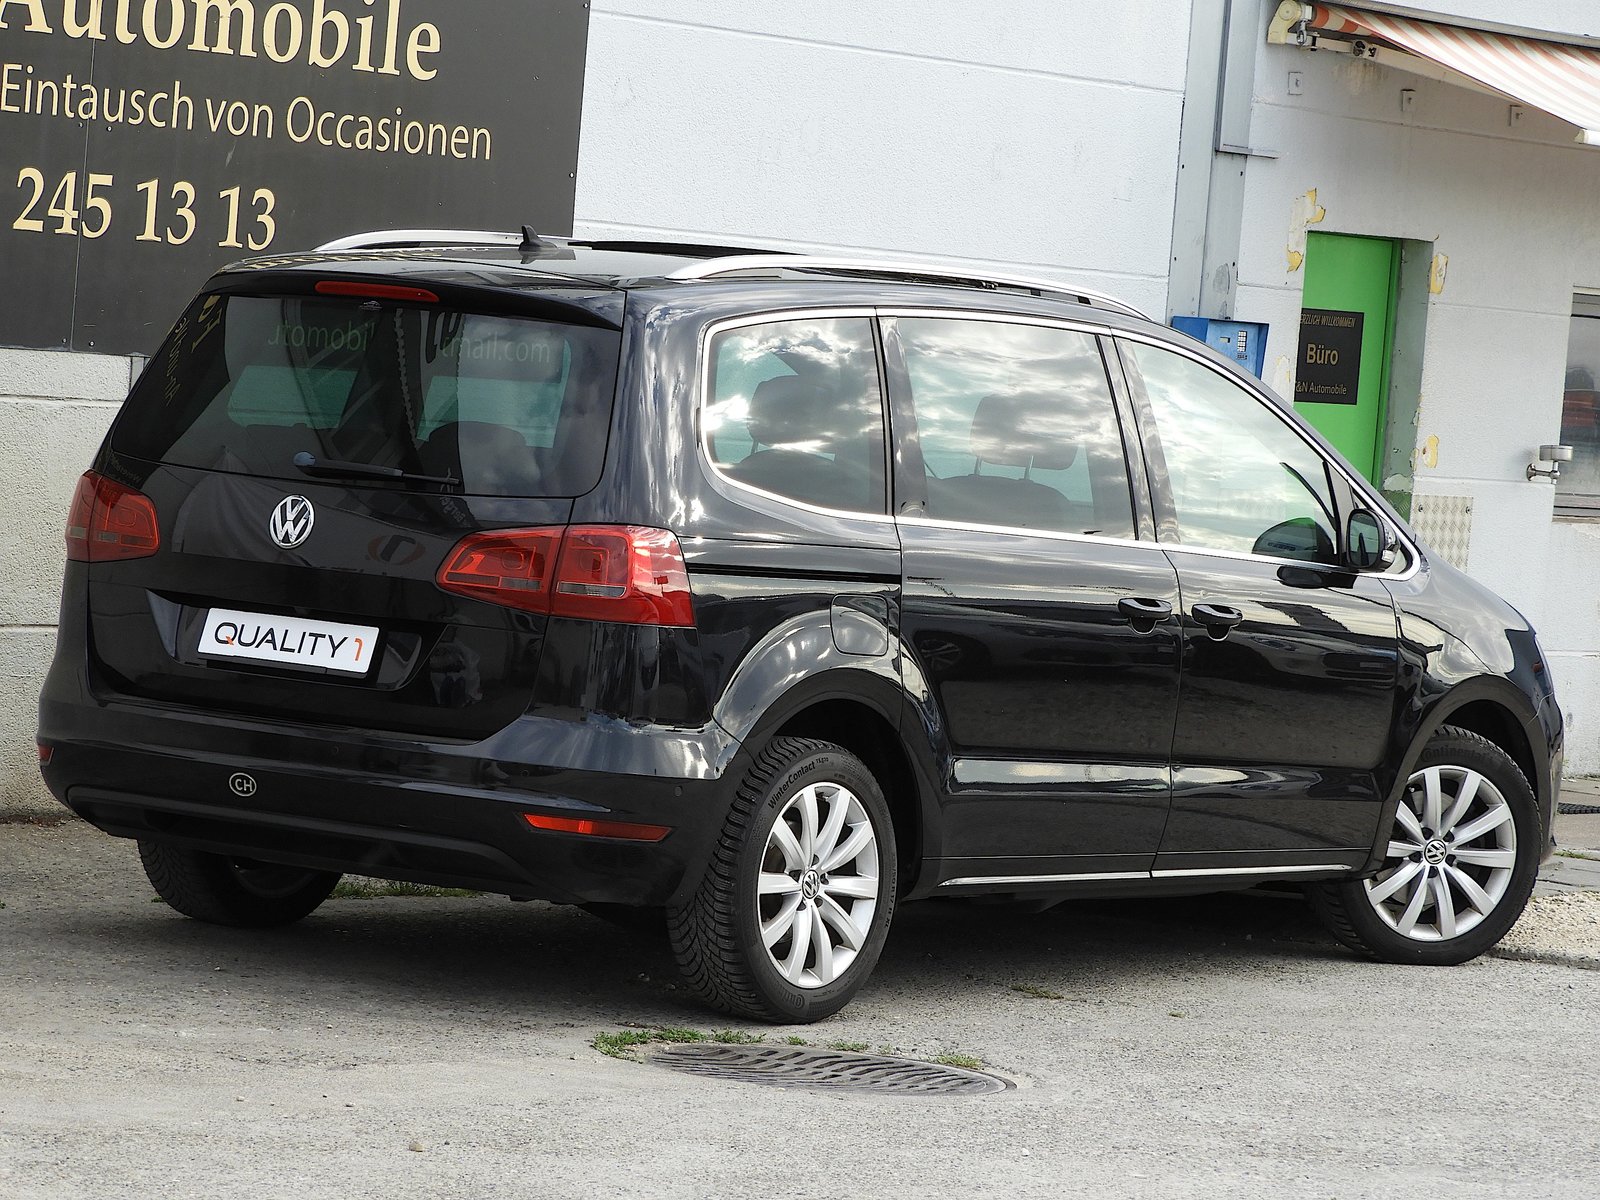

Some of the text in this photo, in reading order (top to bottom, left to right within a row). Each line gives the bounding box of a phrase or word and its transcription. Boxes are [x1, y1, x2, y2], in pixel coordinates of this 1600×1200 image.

[0, 63, 492, 160] Eintausch von Occasionen
[13, 167, 276, 251] 245 13 13
[1300, 313, 1356, 328] ERZLICH WILLKOMMEN
[1306, 343, 1339, 365] Büro
[1295, 380, 1347, 395] &N Automobile
[234, 778, 253, 792] CH
[767, 760, 816, 809] WinterContact
